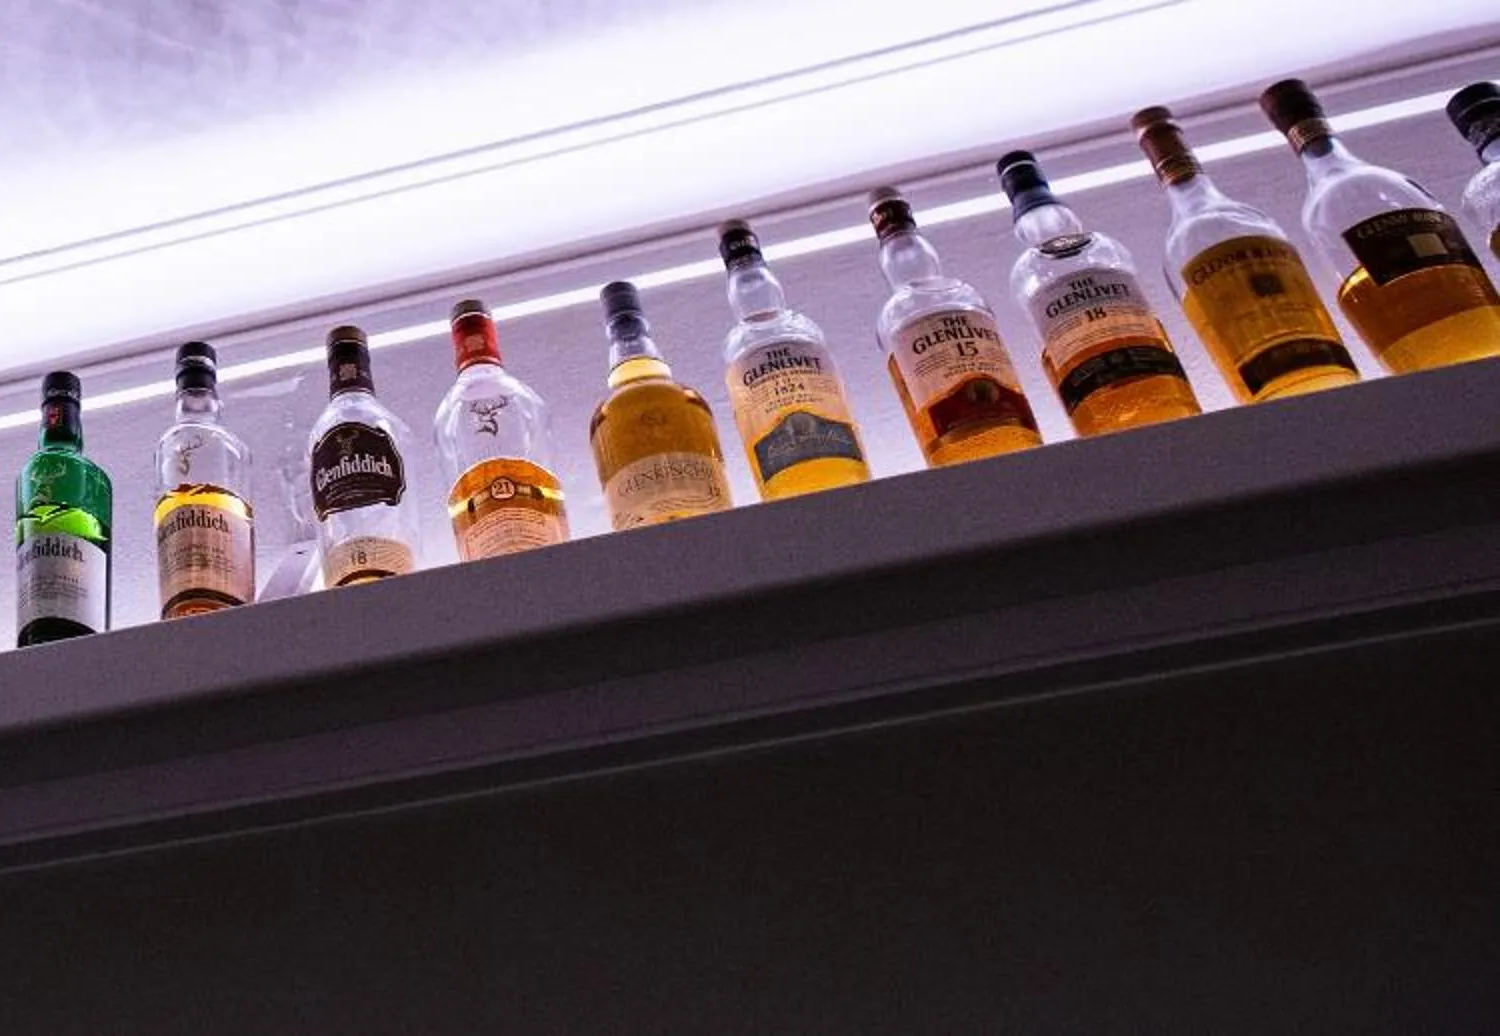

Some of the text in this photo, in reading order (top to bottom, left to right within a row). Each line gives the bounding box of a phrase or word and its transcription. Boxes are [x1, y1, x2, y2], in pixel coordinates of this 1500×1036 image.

[1068, 276, 1095, 291] THE
[1045, 282, 1131, 319] GLENLIVET
[942, 314, 968, 328] THE
[1084, 306, 1107, 323] 18
[912, 326, 1002, 355] GLENLIVET
[766, 346, 791, 360] THE
[955, 341, 979, 357] 15
[743, 356, 821, 387] GLENLIVET
[315, 452, 394, 492] Glenfiddich
[493, 480, 512, 495] 21
[351, 551, 368, 566] 18
